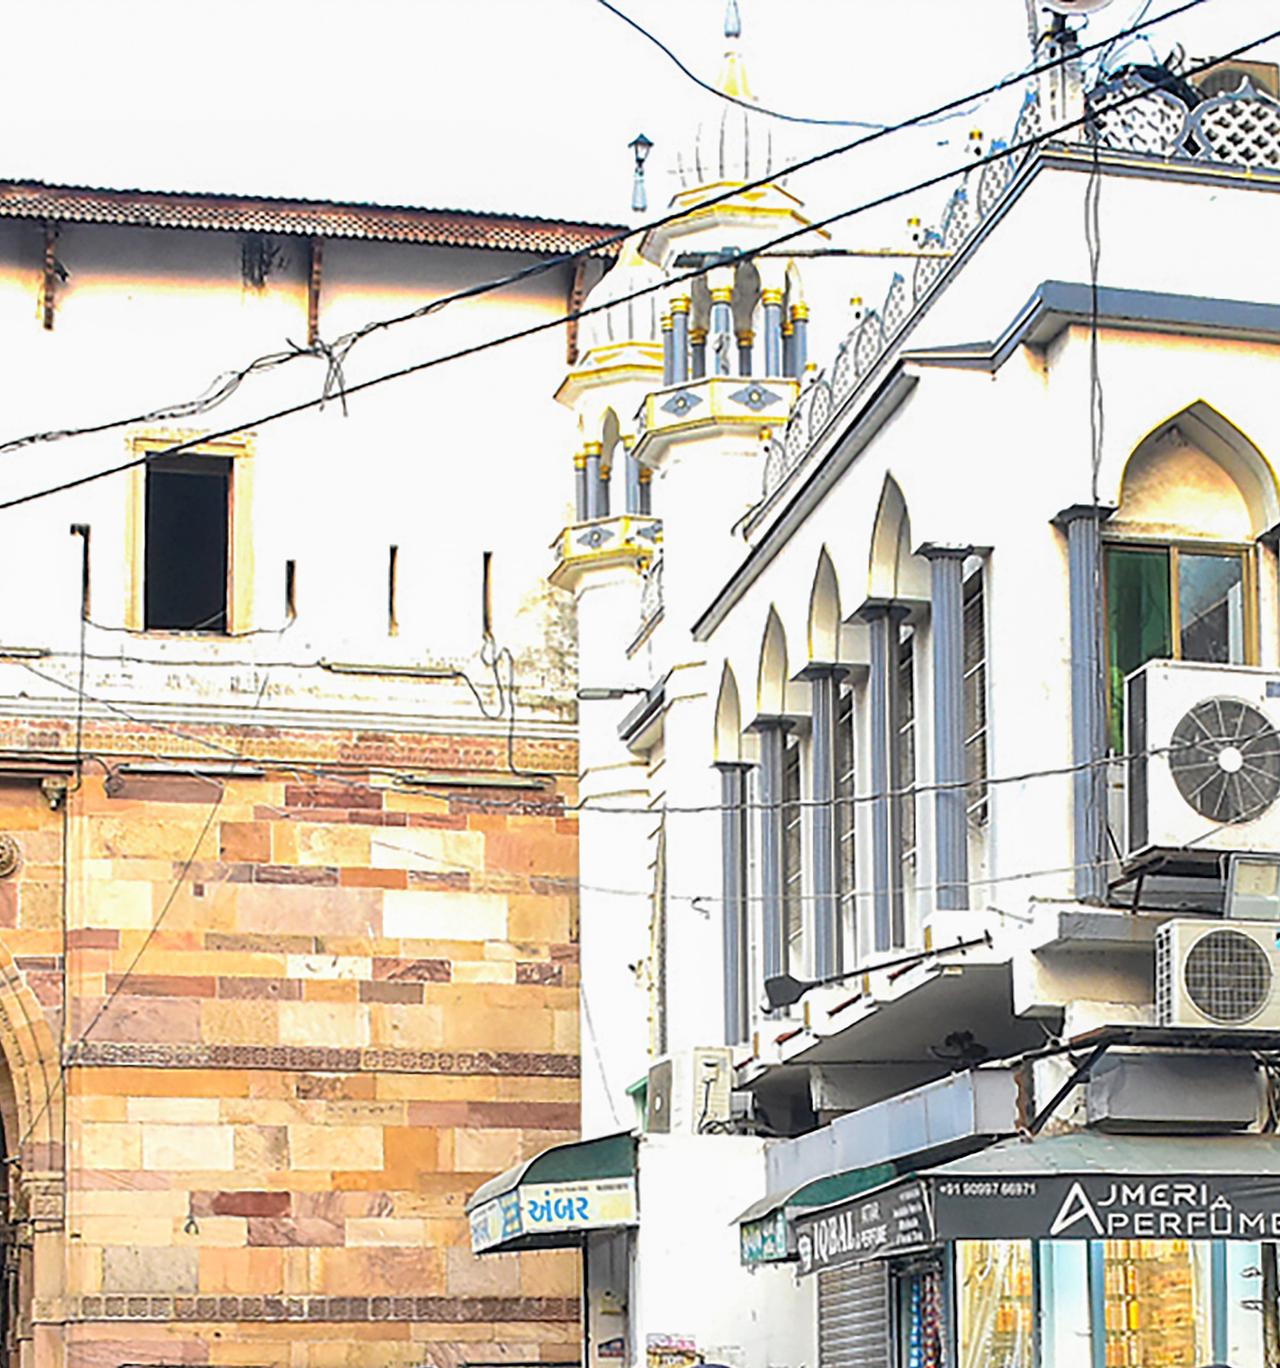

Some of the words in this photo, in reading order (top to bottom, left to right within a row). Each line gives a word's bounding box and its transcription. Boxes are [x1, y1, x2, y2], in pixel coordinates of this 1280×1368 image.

[527, 1190, 590, 1223] અંબર
[1050, 1182, 1208, 1236] AJMERI
[814, 1211, 854, 1263] IQBAL
